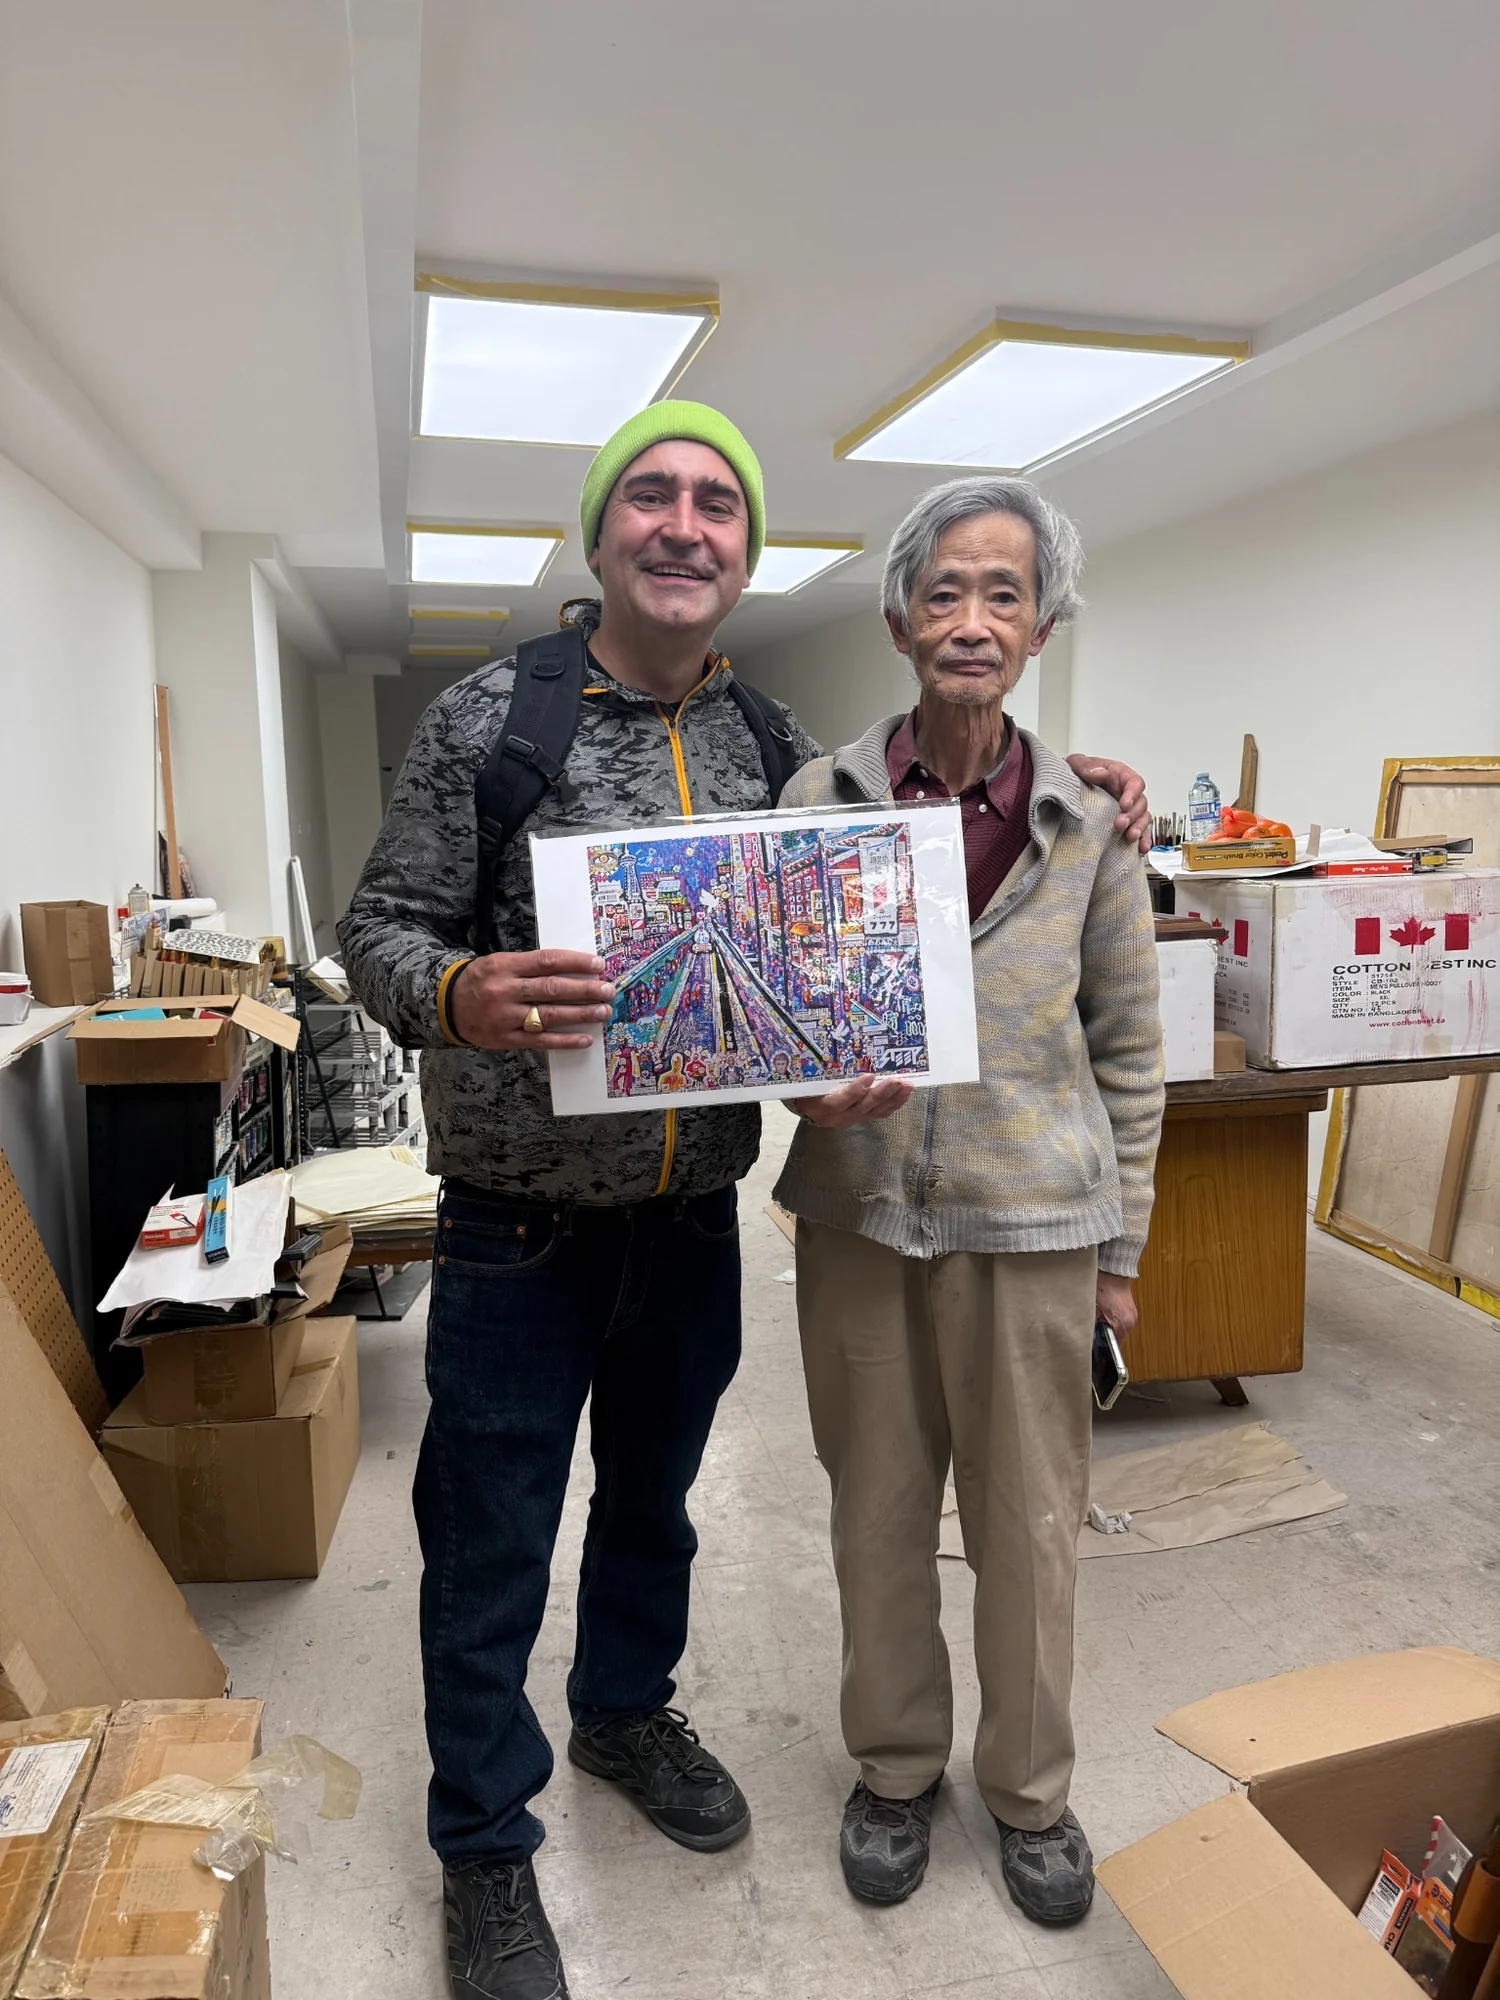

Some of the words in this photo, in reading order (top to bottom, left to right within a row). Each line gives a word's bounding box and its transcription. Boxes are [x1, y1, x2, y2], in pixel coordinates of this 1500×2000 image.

[1333, 962, 1411, 975] COTTON
[1424, 960, 1464, 970] EST
[1468, 959, 1497, 969] INC
[1368, 1009, 1422, 1017] BANGLADESH
